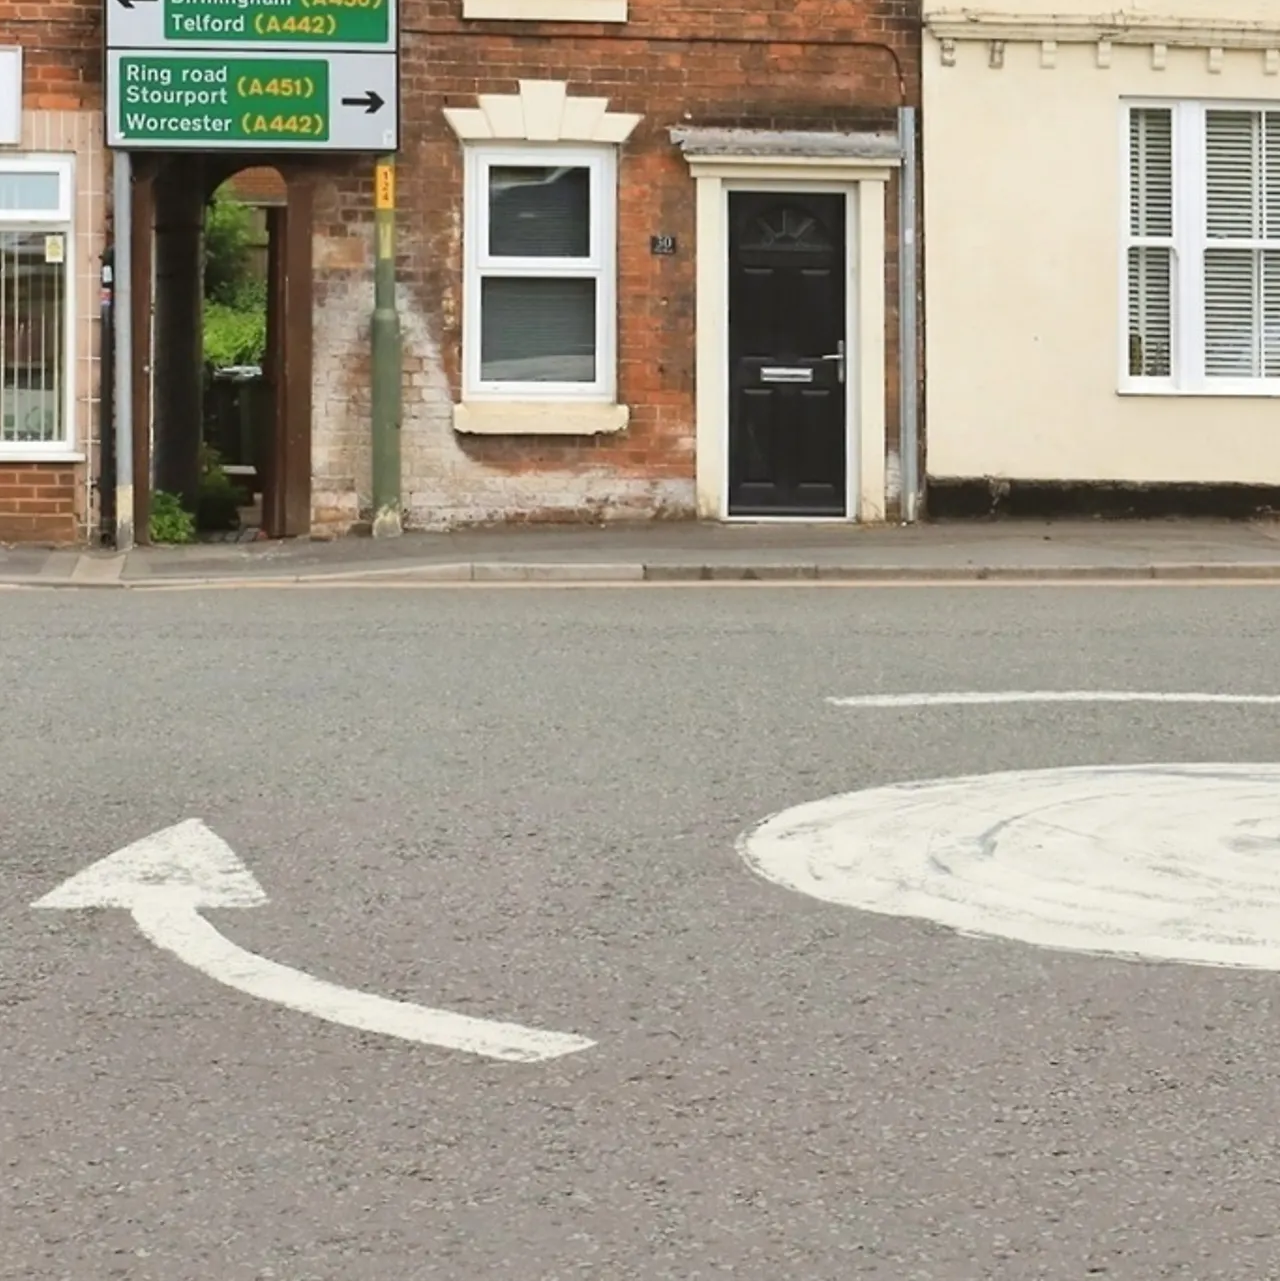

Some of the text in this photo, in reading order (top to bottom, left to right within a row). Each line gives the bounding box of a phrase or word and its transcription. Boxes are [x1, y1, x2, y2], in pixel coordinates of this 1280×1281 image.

[172, 14, 336, 35] Telford (A442)
[126, 64, 227, 85] Ring road
[126, 86, 228, 107] Stourport
[237, 77, 314, 98] (A451)
[126, 113, 324, 135] Worcester (A442)
